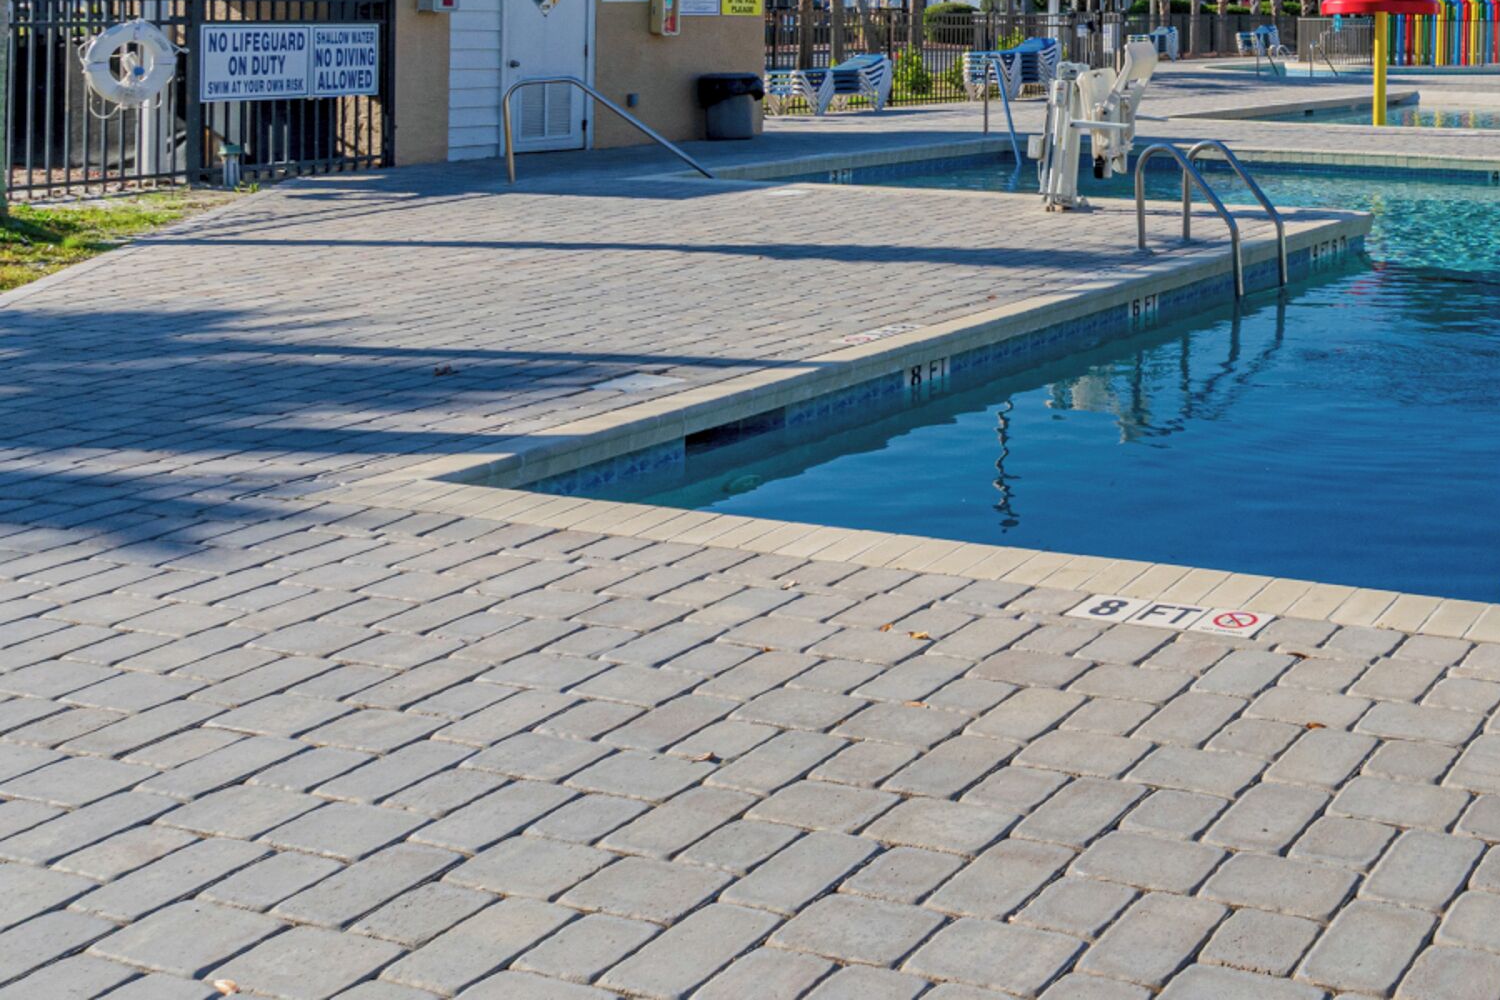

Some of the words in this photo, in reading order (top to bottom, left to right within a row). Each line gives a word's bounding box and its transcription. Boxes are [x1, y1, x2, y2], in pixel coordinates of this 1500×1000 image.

[731, 5, 754, 13] PLEASE
[208, 32, 228, 52] NO
[232, 31, 305, 51] LIFEGUARD
[316, 32, 348, 44] SHALLOW
[351, 32, 374, 43] WATER
[228, 56, 247, 76] ON
[251, 55, 286, 75] DUTY
[315, 49, 332, 67] NO
[336, 48, 375, 66] DIVING
[208, 81, 229, 94] SWIM
[231, 80, 243, 93] AT
[244, 80, 264, 93] YOUR
[267, 79, 284, 92] OWN
[286, 78, 304, 91] RISK
[317, 70, 373, 90] ALLOWED
[1491, 171, 1499, 186] 4
[1133, 299, 1140, 317] 6
[1145, 293, 1156, 312] FT
[911, 365, 921, 386] 8
[929, 357, 947, 381] FT
[1088, 600, 1128, 616] 8
[1137, 604, 1202, 624] FT
